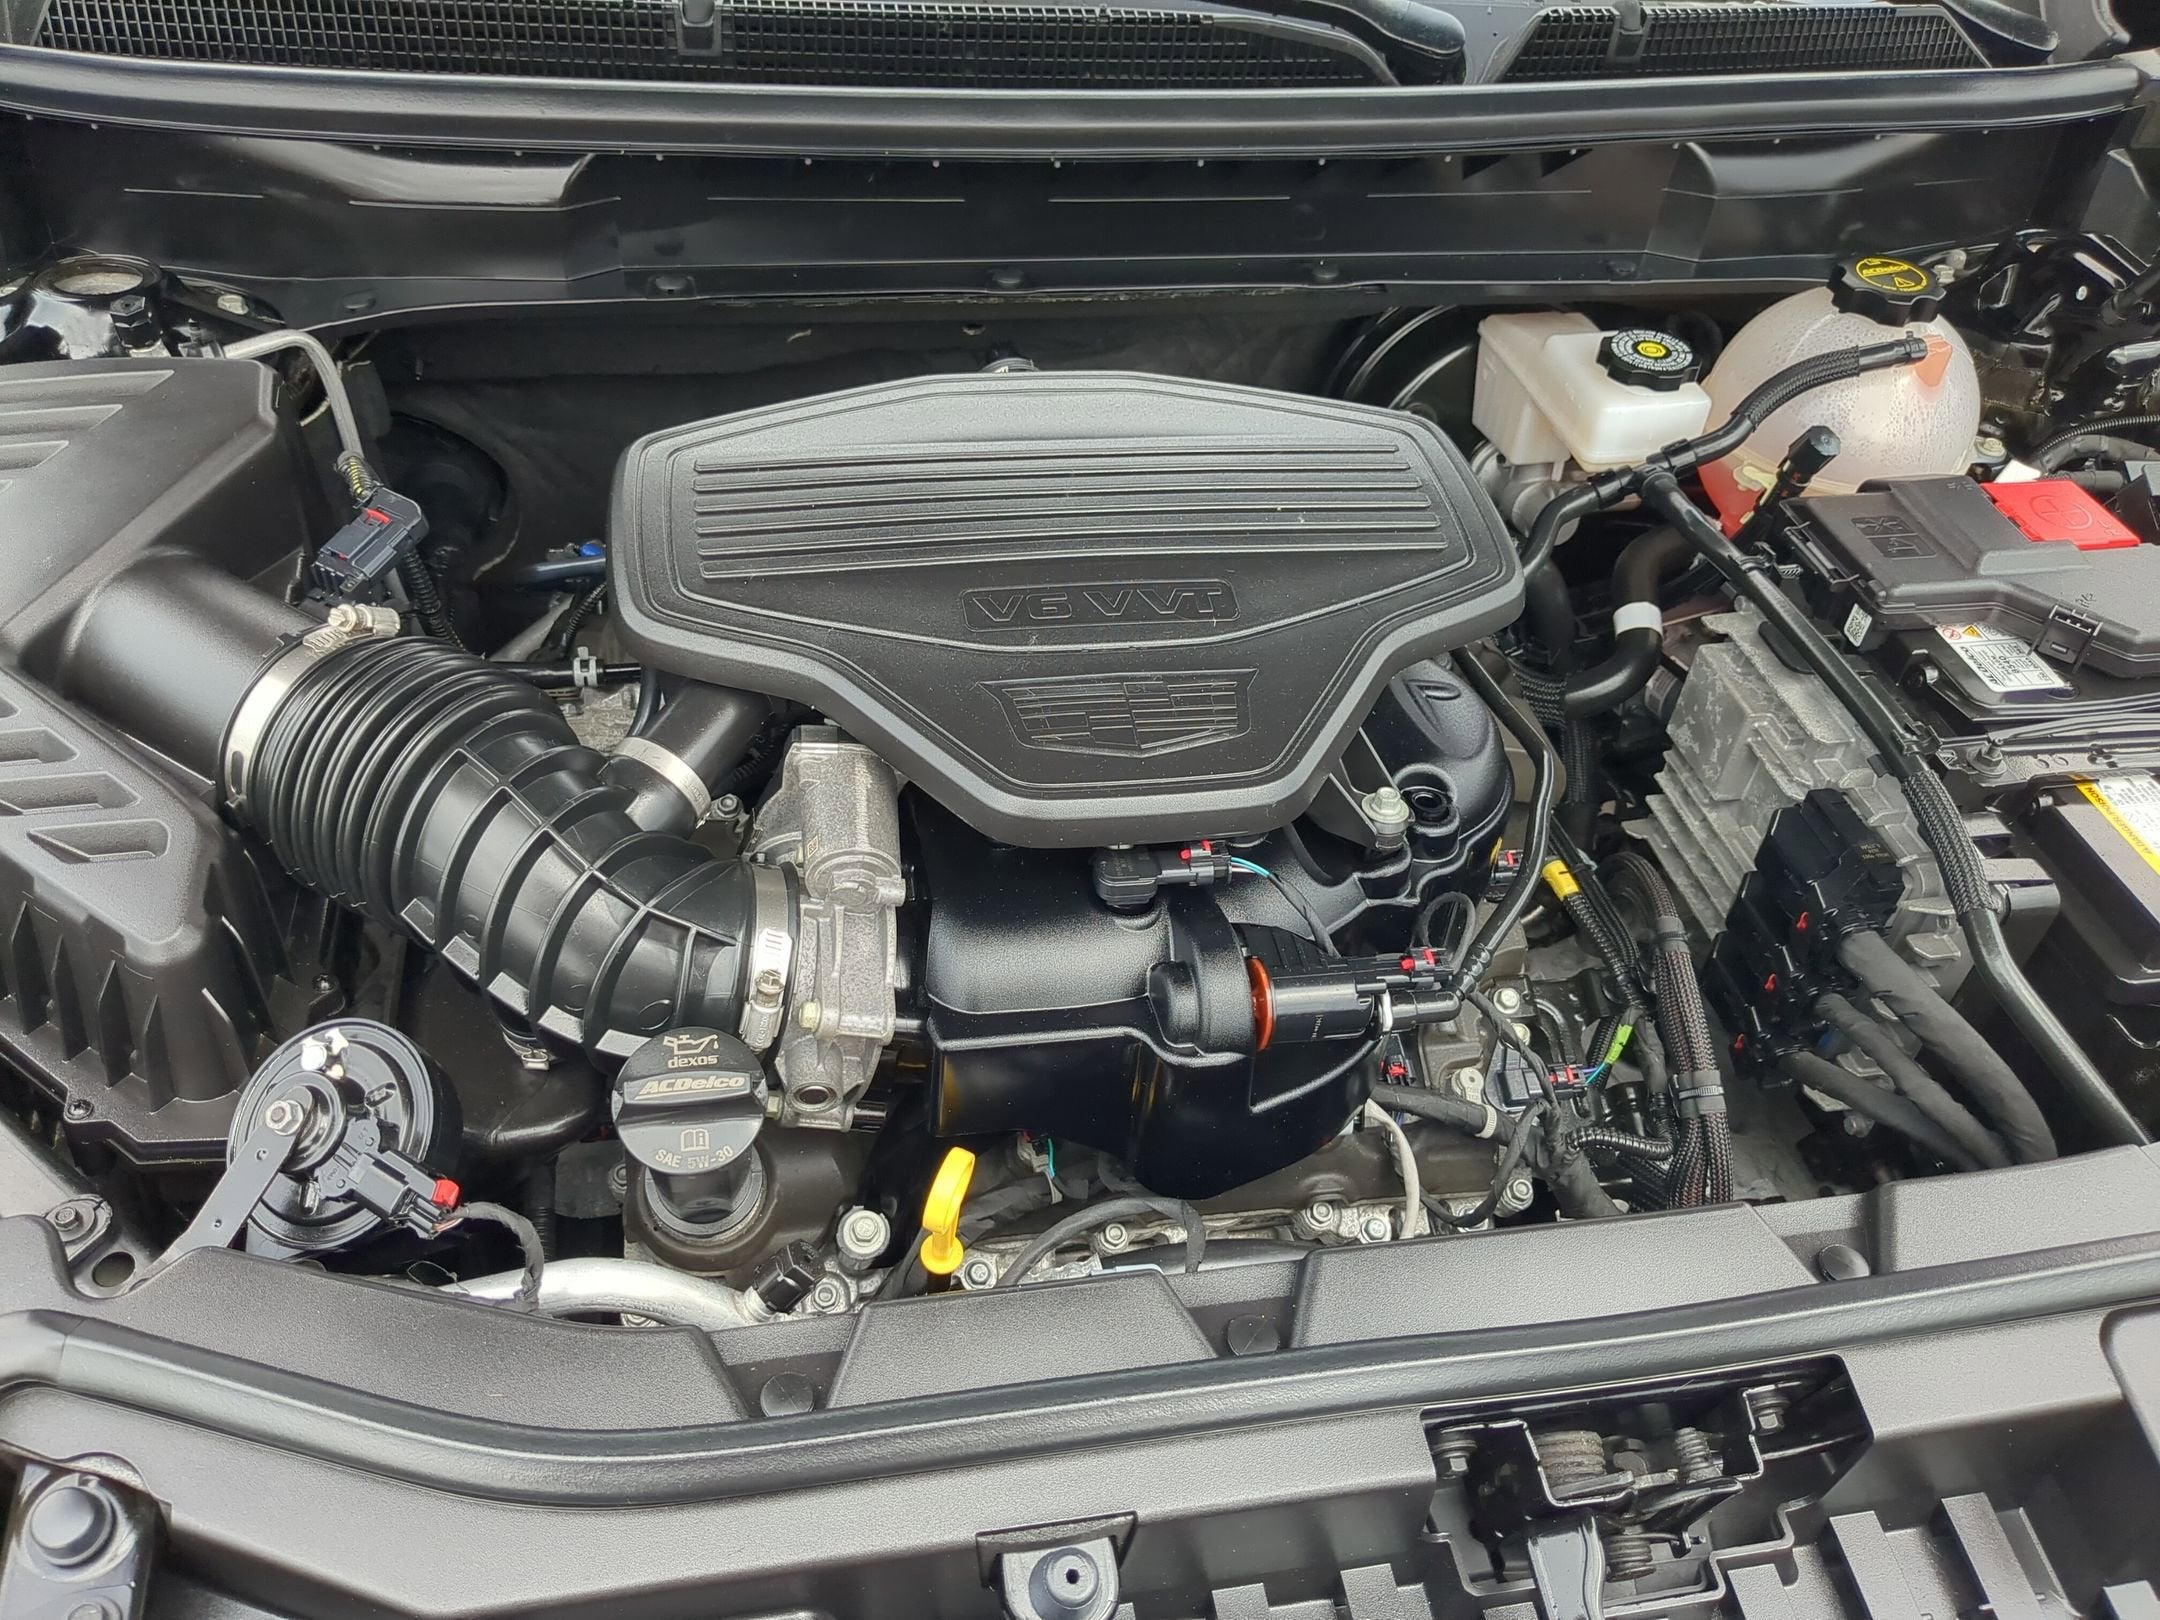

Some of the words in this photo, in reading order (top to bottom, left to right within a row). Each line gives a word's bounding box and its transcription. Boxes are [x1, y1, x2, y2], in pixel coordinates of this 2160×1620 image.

[973, 593, 1072, 622] V6
[1084, 587, 1222, 615] VVT
[668, 1056, 718, 1069] dexos
[640, 1077, 745, 1094] ACDelco
[656, 1149, 681, 1167] SAE
[688, 1146, 733, 1169] 5W-30
